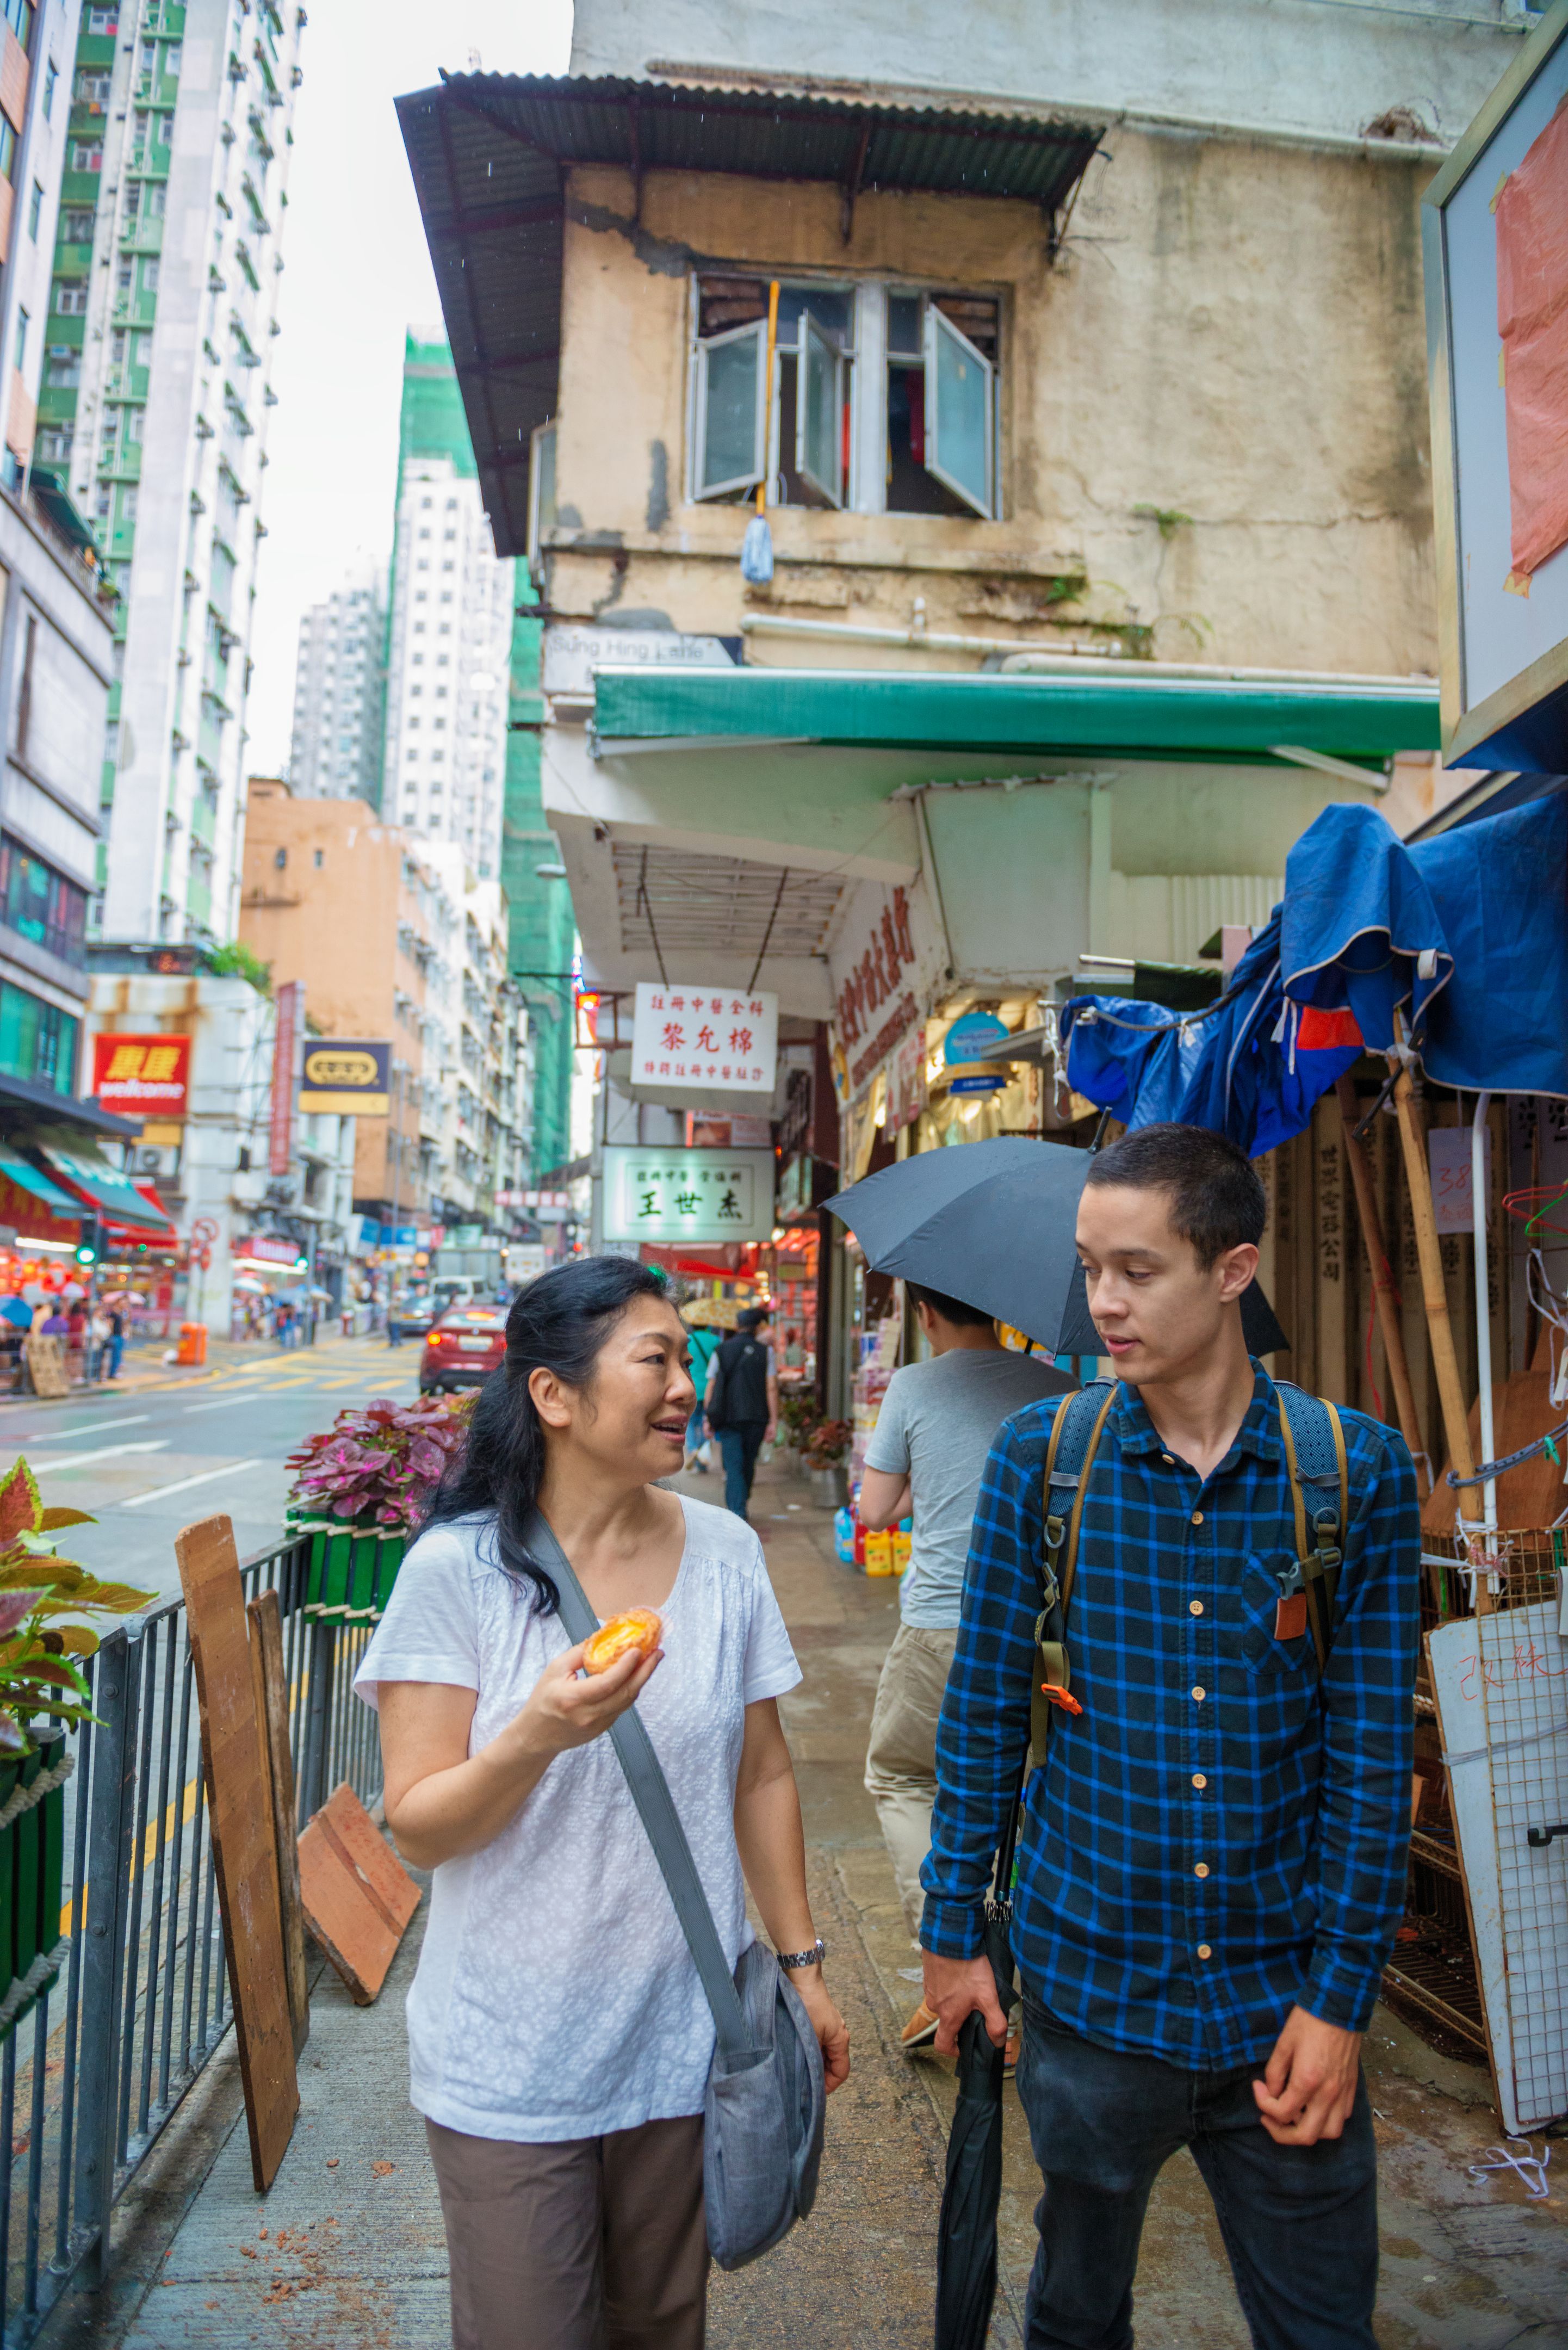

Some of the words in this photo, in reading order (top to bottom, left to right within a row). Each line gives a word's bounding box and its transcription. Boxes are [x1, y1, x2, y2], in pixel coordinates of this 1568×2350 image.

[554, 635, 600, 656] Sung
[606, 639, 648, 660] Hing
[655, 641, 703, 660] Lane
[652, 995, 763, 1016] 註冊中醫全科
[660, 1023, 753, 1055] 黎允棉
[105, 1045, 182, 1081] 惠康
[638, 1188, 742, 1220] 王世杰
